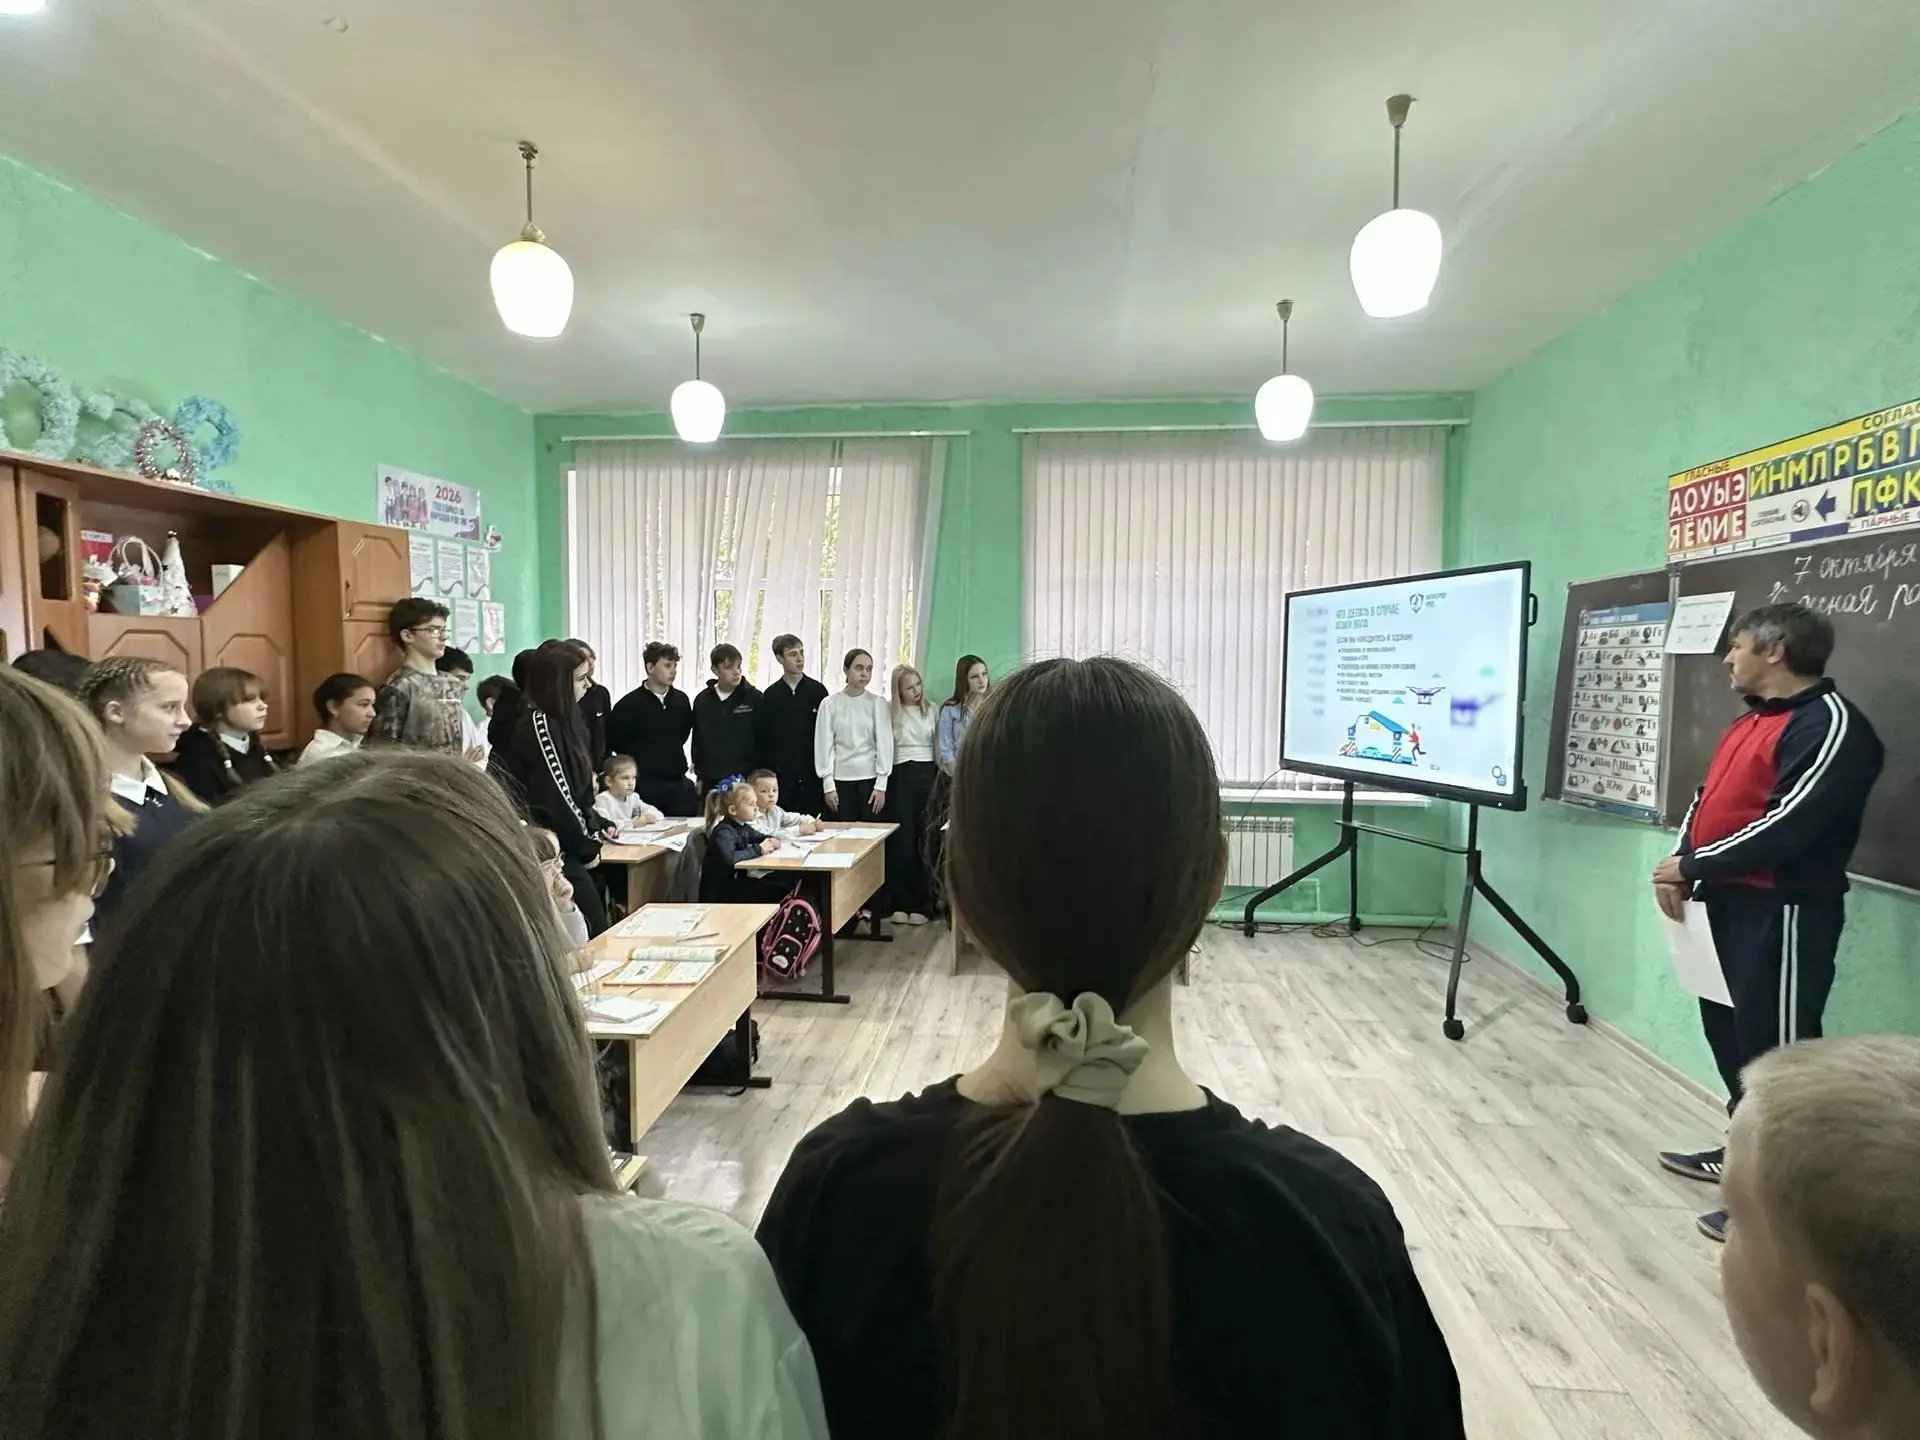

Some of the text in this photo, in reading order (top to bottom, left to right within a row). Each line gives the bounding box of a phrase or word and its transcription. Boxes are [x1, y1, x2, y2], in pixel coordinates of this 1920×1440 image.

[1683, 461, 1730, 482] ГЛАСНЫЕ
[435, 484, 462, 504] 2026
[1860, 511, 1911, 529] ПАРНЫЕ
[1793, 555, 1813, 585] 7
[1819, 538, 1917, 581] октября
